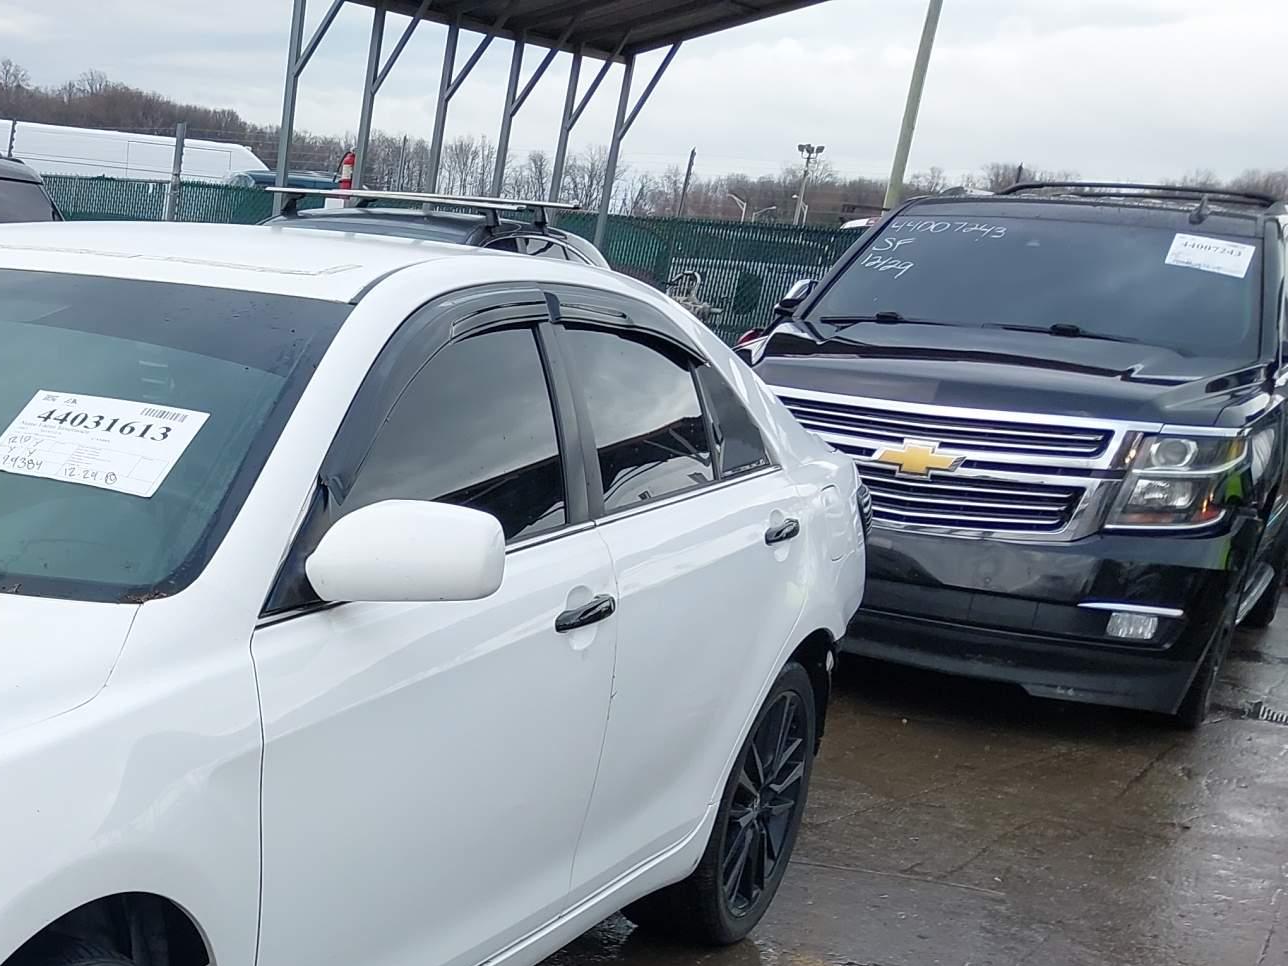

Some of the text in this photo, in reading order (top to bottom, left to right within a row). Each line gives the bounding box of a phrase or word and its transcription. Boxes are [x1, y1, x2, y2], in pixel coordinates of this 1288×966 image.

[890, 221, 1008, 238] 44007243
[872, 237, 916, 251] SF
[861, 253, 914, 279] 12/29
[37, 409, 172, 441] 44031613
